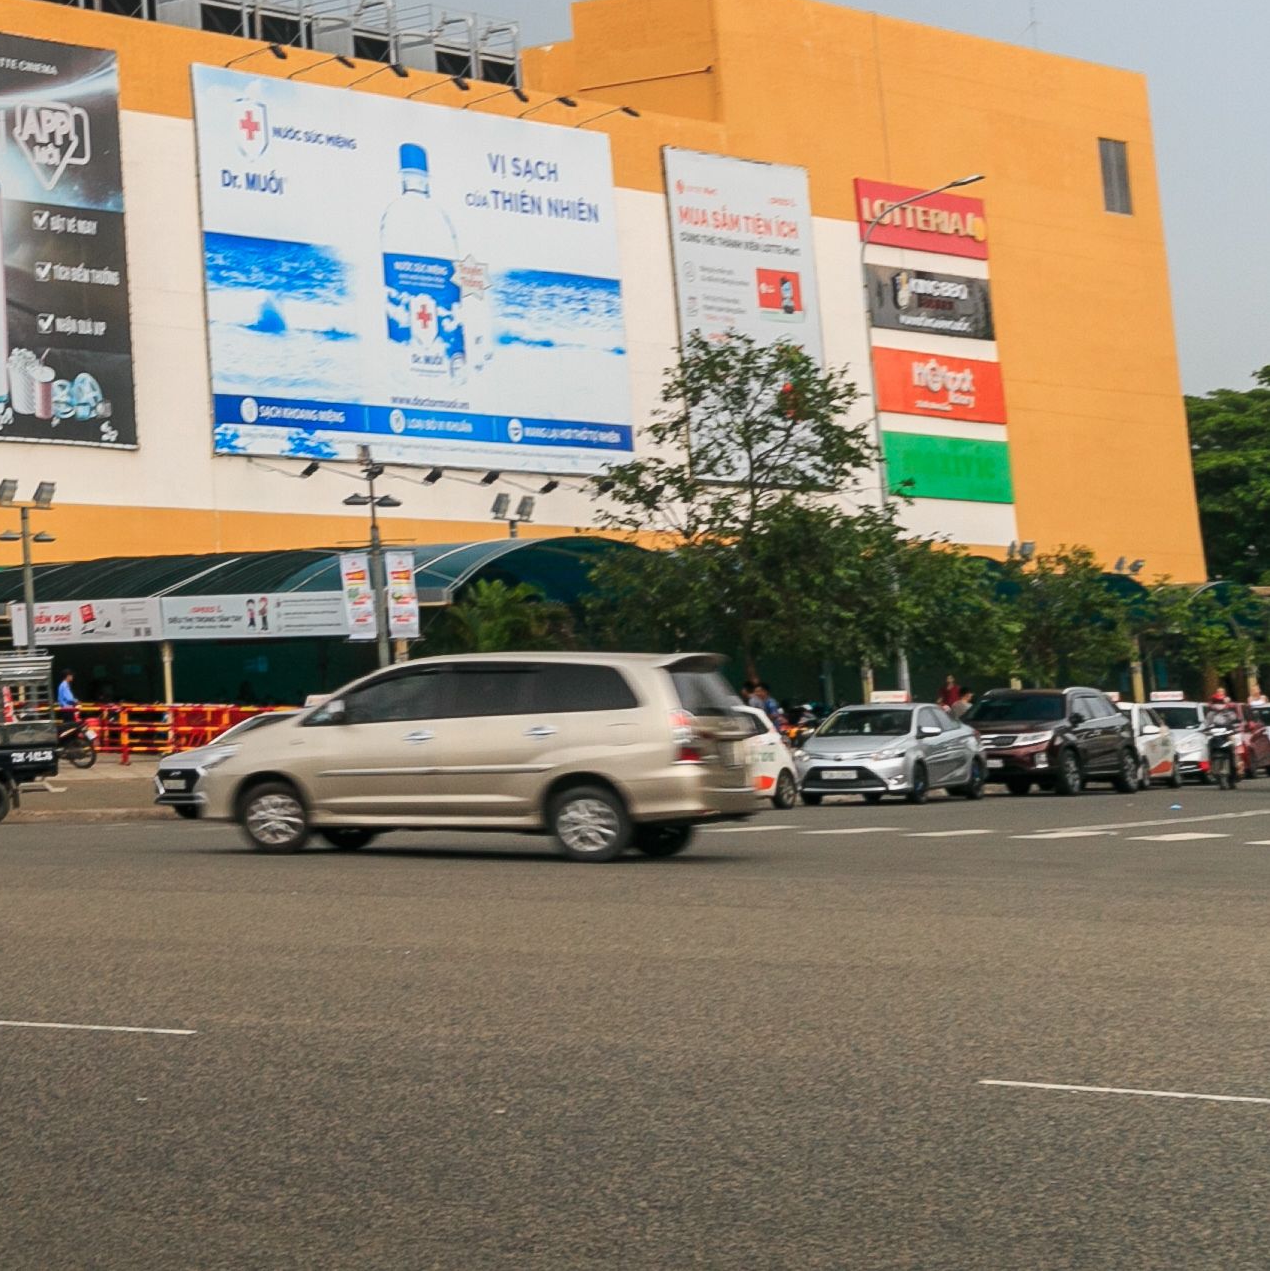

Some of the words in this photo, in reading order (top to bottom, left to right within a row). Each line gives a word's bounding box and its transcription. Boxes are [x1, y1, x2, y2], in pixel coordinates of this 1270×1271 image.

[21, 105, 73, 146] APP
[221, 169, 242, 189] Dr.
[487, 152, 507, 179] VỊ
[511, 156, 559, 183] SẠCH
[677, 205, 708, 226] MUA
[861, 197, 964, 238] LOTTERIA
